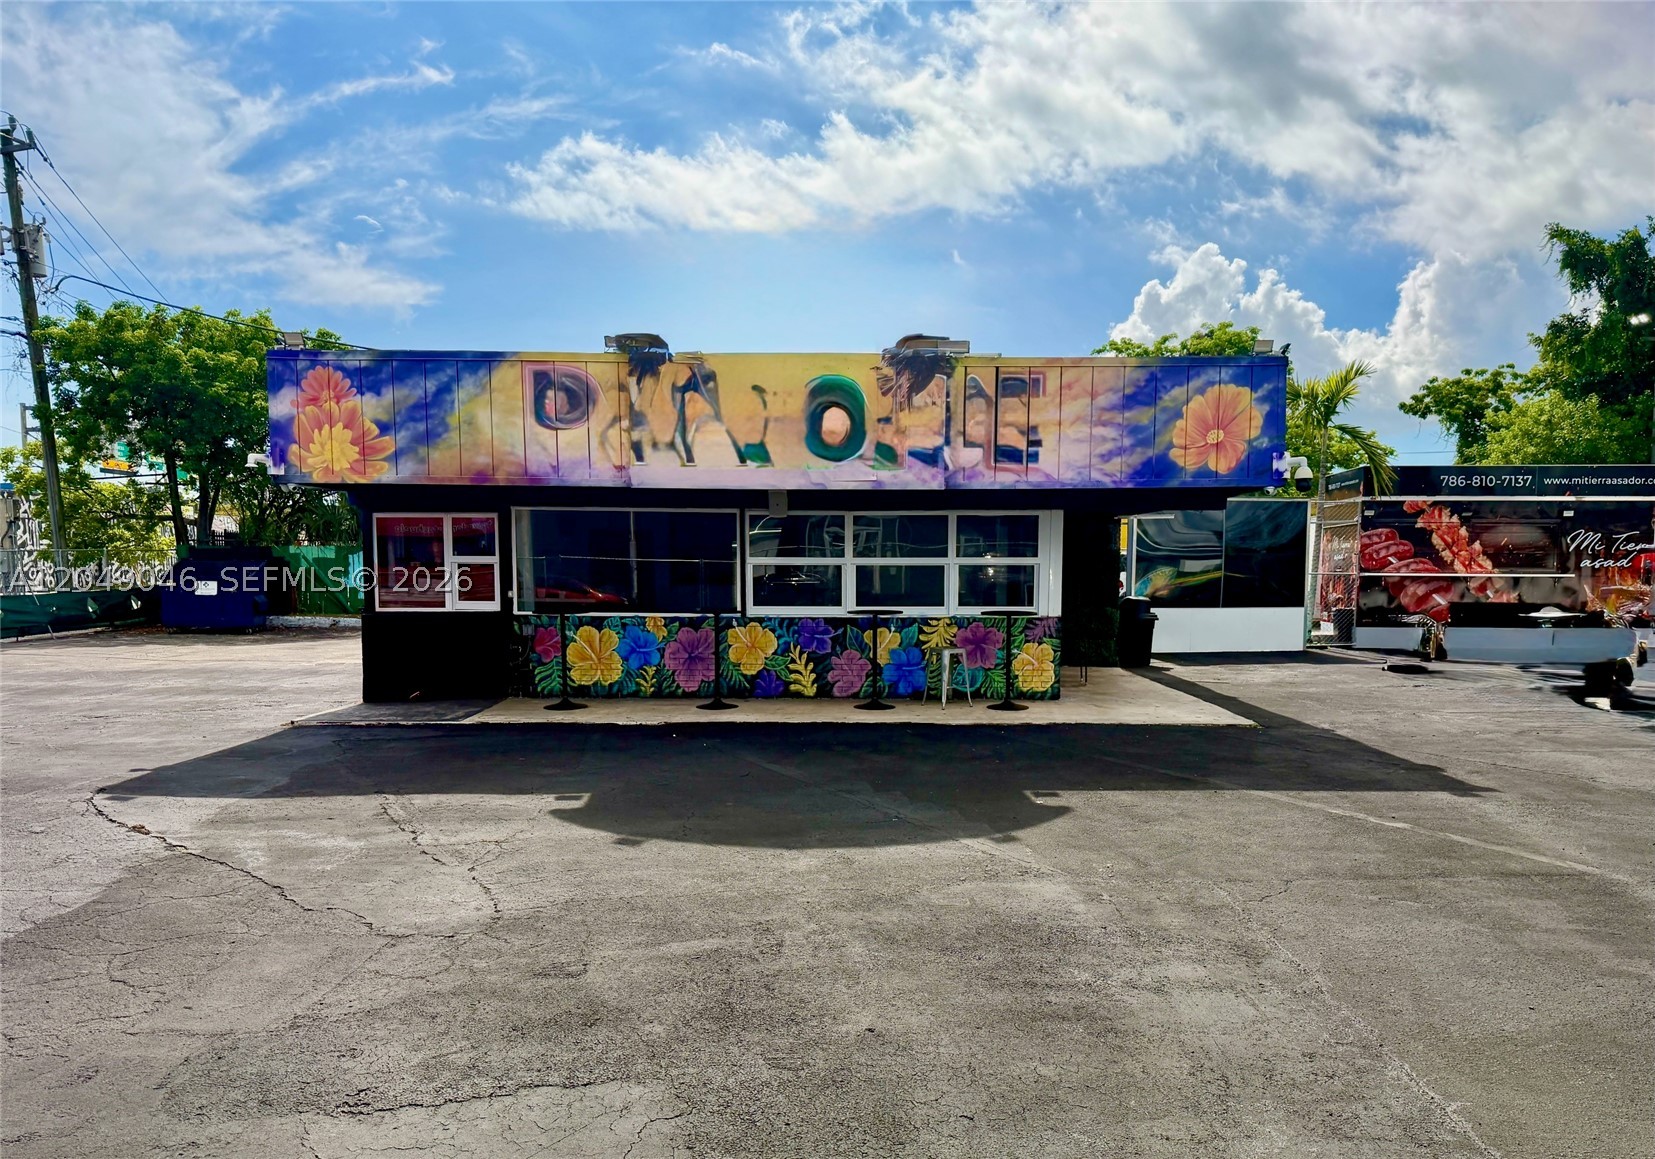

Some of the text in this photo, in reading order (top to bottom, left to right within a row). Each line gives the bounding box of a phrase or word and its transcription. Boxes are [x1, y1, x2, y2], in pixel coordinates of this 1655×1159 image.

[1440, 475, 1532, 487] 786-810-7137
[1543, 475, 1655, 485] www.mitierraasador.c
[1566, 529, 1605, 554] Mi
